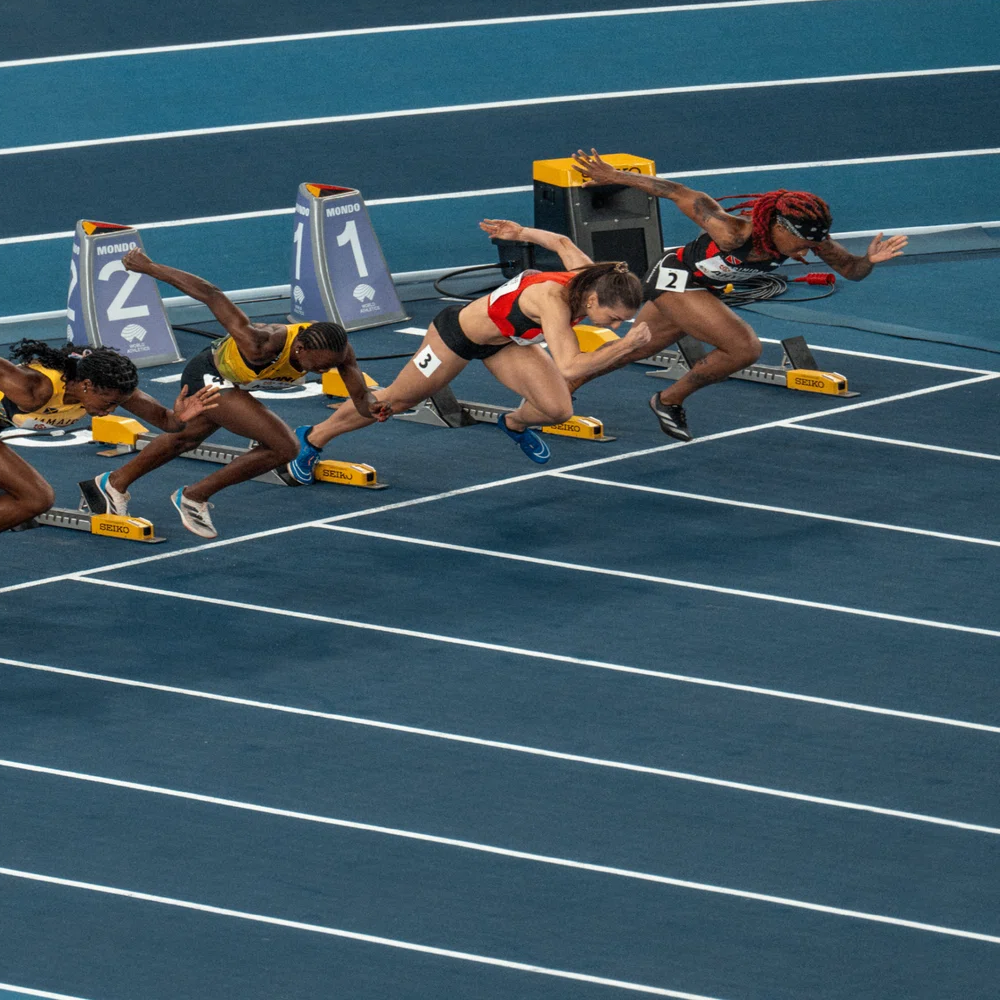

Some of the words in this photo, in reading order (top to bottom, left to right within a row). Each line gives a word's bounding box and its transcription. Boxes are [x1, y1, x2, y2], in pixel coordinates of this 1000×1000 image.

[326, 202, 361, 218] MONDO
[96, 241, 137, 256] MONDO
[336, 219, 369, 278] 1
[665, 272, 679, 289] 2
[98, 259, 150, 322] 2
[419, 353, 432, 369] 3
[795, 377, 825, 389] SEIKO
[549, 423, 581, 434] SEIKO
[322, 470, 353, 481] SEIKO
[99, 523, 131, 534] SEIKO
